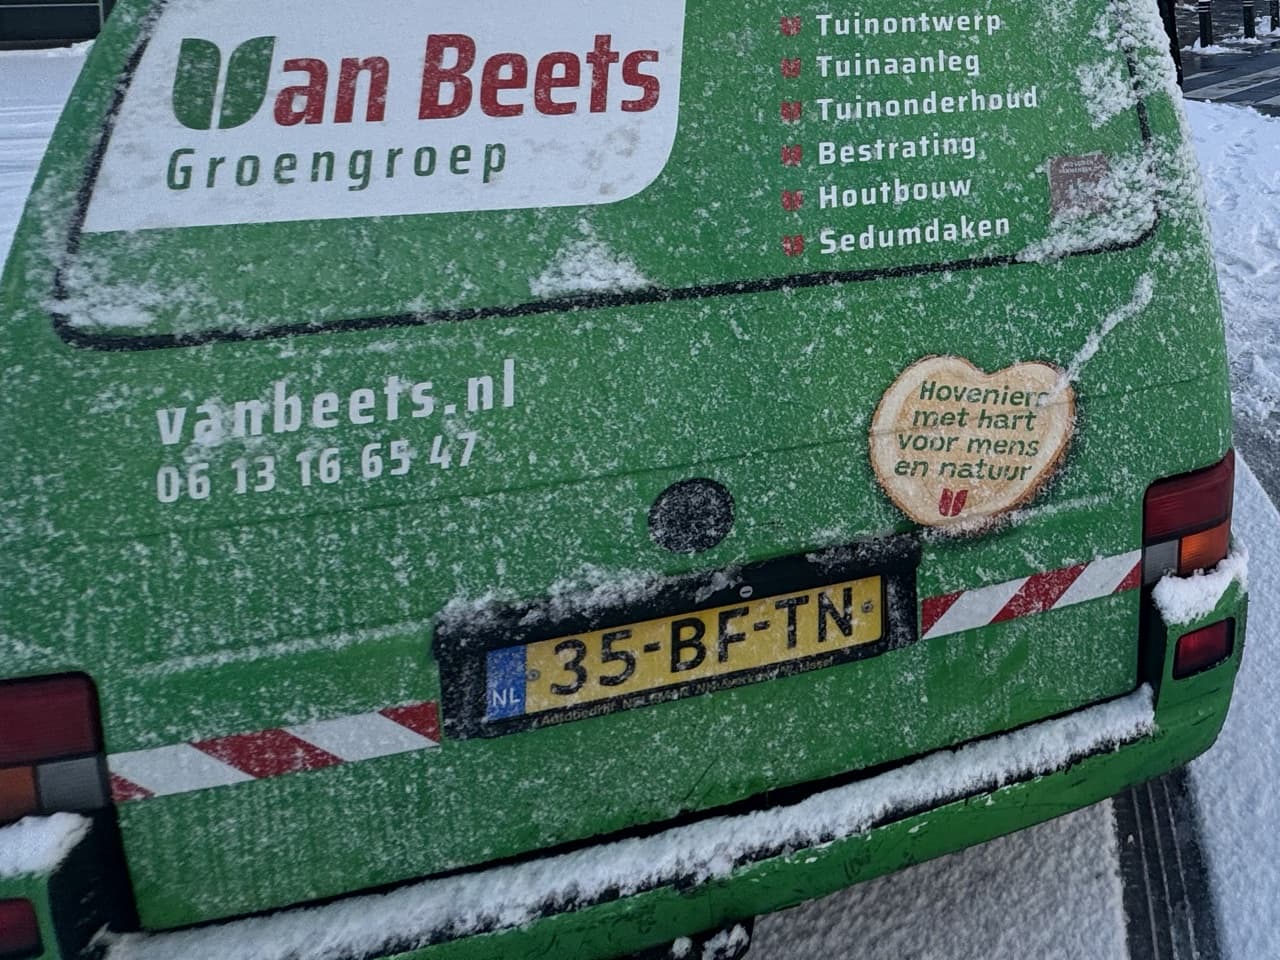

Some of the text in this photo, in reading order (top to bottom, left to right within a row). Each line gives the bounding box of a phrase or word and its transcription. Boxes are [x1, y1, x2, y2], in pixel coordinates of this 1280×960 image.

[816, 12, 1001, 37] Tuinontwerp
[418, 33, 660, 120] Beets
[816, 51, 981, 77] Tuinaanleg
[816, 86, 1038, 121] Tuinonderhoud
[818, 133, 976, 166] Bestrating
[166, 141, 508, 192] Groengroep
[818, 178, 971, 210] Houtbouw
[819, 214, 1010, 255] Sedumdaken
[156, 358, 515, 445] vanbeets.nl
[913, 407, 1037, 431] met hart
[898, 433, 1040, 457] voor mens
[156, 431, 478, 503] 06 13 16 65 47
[894, 458, 1033, 481] en natuur
[550, 586, 855, 697] 35-BF-TN
[492, 687, 521, 709] NL
